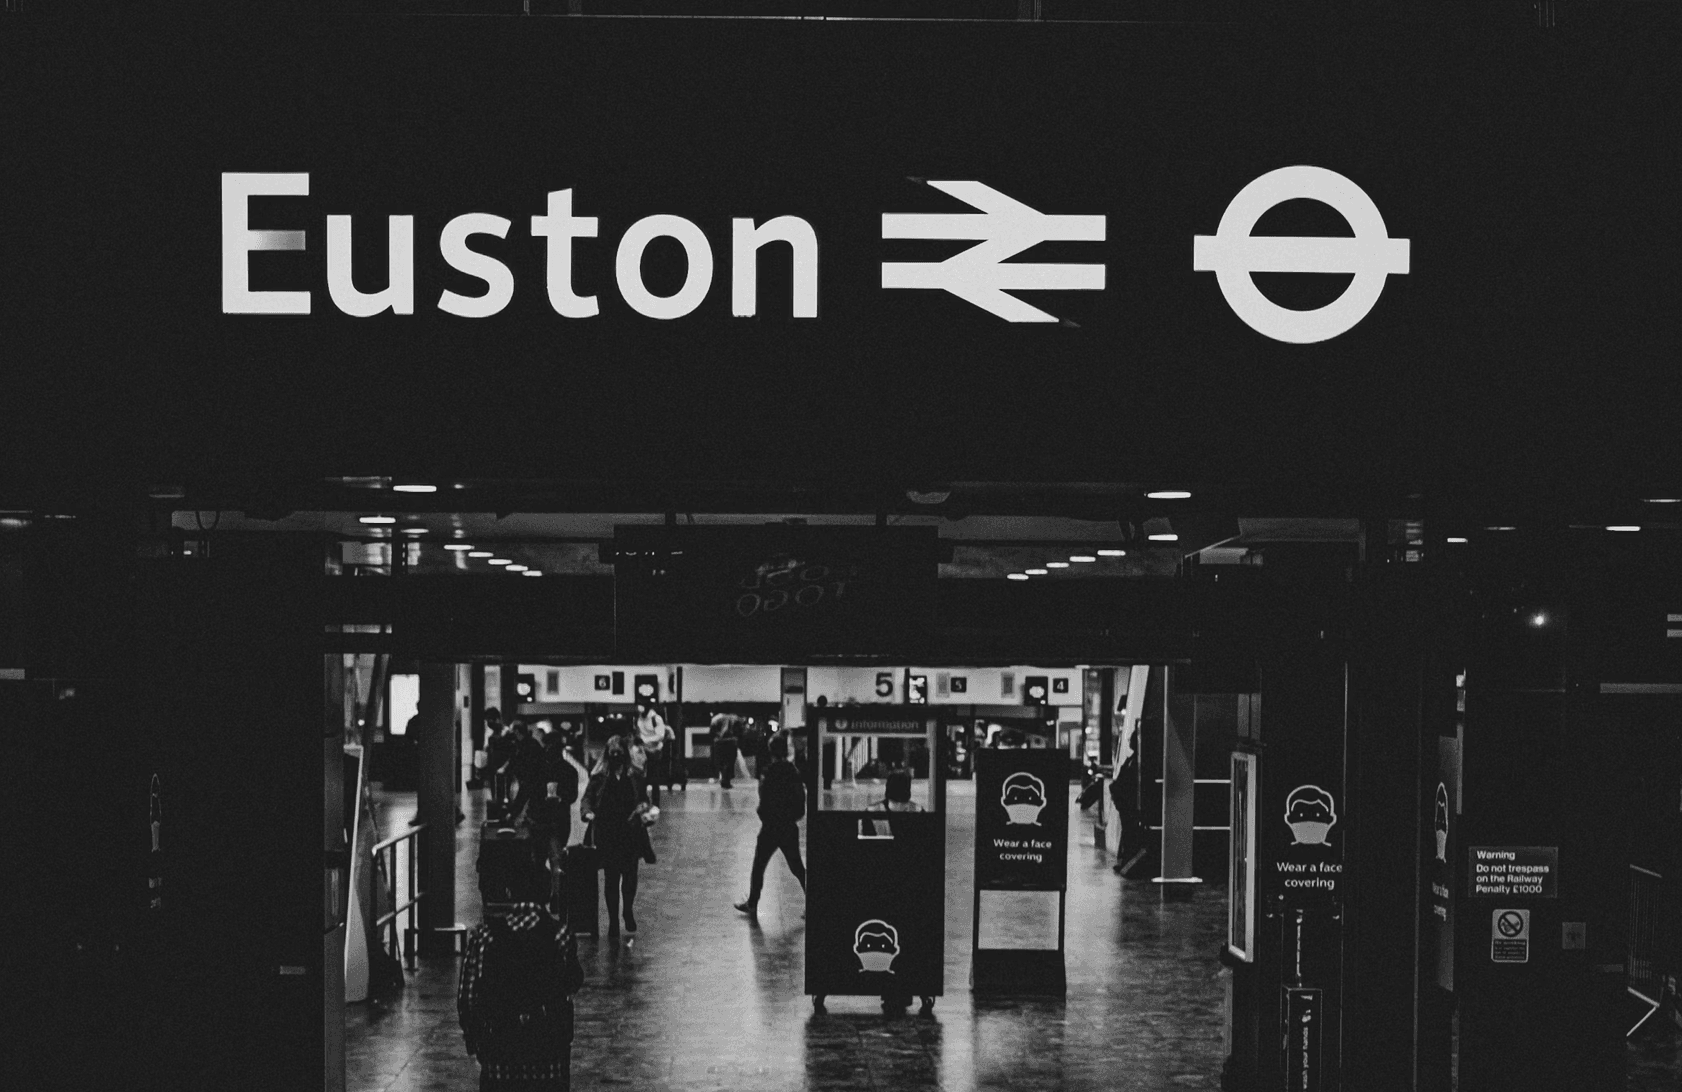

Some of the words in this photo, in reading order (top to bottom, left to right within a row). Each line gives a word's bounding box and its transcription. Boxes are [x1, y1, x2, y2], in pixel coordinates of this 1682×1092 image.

[221, 172, 819, 320] Euston
[598, 677, 607, 689] 6
[875, 672, 894, 698] 5
[955, 680, 963, 691] 5
[1056, 680, 1065, 691] 4
[993, 838, 1020, 849] Wear
[1022, 840, 1029, 848] a
[1031, 838, 1052, 849] face
[999, 852, 1043, 864] covering
[1476, 850, 1516, 861] Warning
[1276, 861, 1308, 873] Wear
[1309, 864, 1317, 873] a
[1319, 861, 1343, 873] face
[1476, 863, 1490, 873] Do
[1491, 864, 1507, 873] not
[1508, 864, 1550, 874] trespass
[1284, 876, 1335, 891] covering
[1476, 875, 1489, 883] on
[1490, 874, 1506, 883] the
[1507, 874, 1543, 885] Railway
[1476, 884, 1511, 895] Penalty
[1512, 884, 1543, 894] £1000
